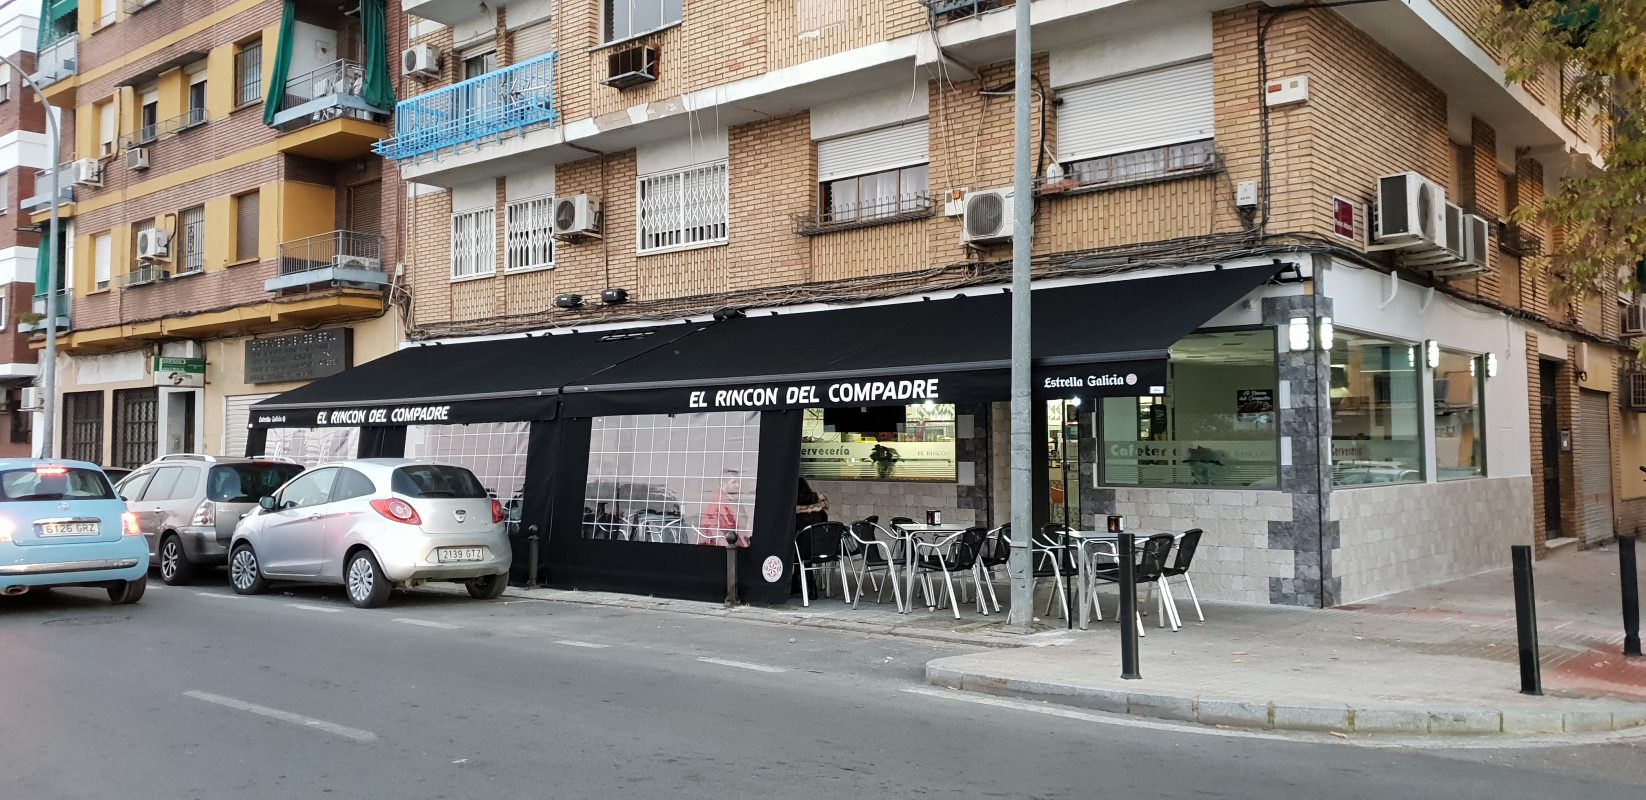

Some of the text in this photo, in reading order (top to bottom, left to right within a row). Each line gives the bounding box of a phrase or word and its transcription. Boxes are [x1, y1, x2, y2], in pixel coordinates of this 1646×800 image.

[1044, 374, 1124, 388] Estrella Galicia
[690, 378, 939, 407] EL RINCON DEL COMPADRE
[316, 405, 450, 424] EL RINCON DEL COMPADRE
[800, 445, 850, 456] ervecería
[45, 523, 95, 534] 6126 GRZ
[443, 549, 481, 559] 2139 GTZ
